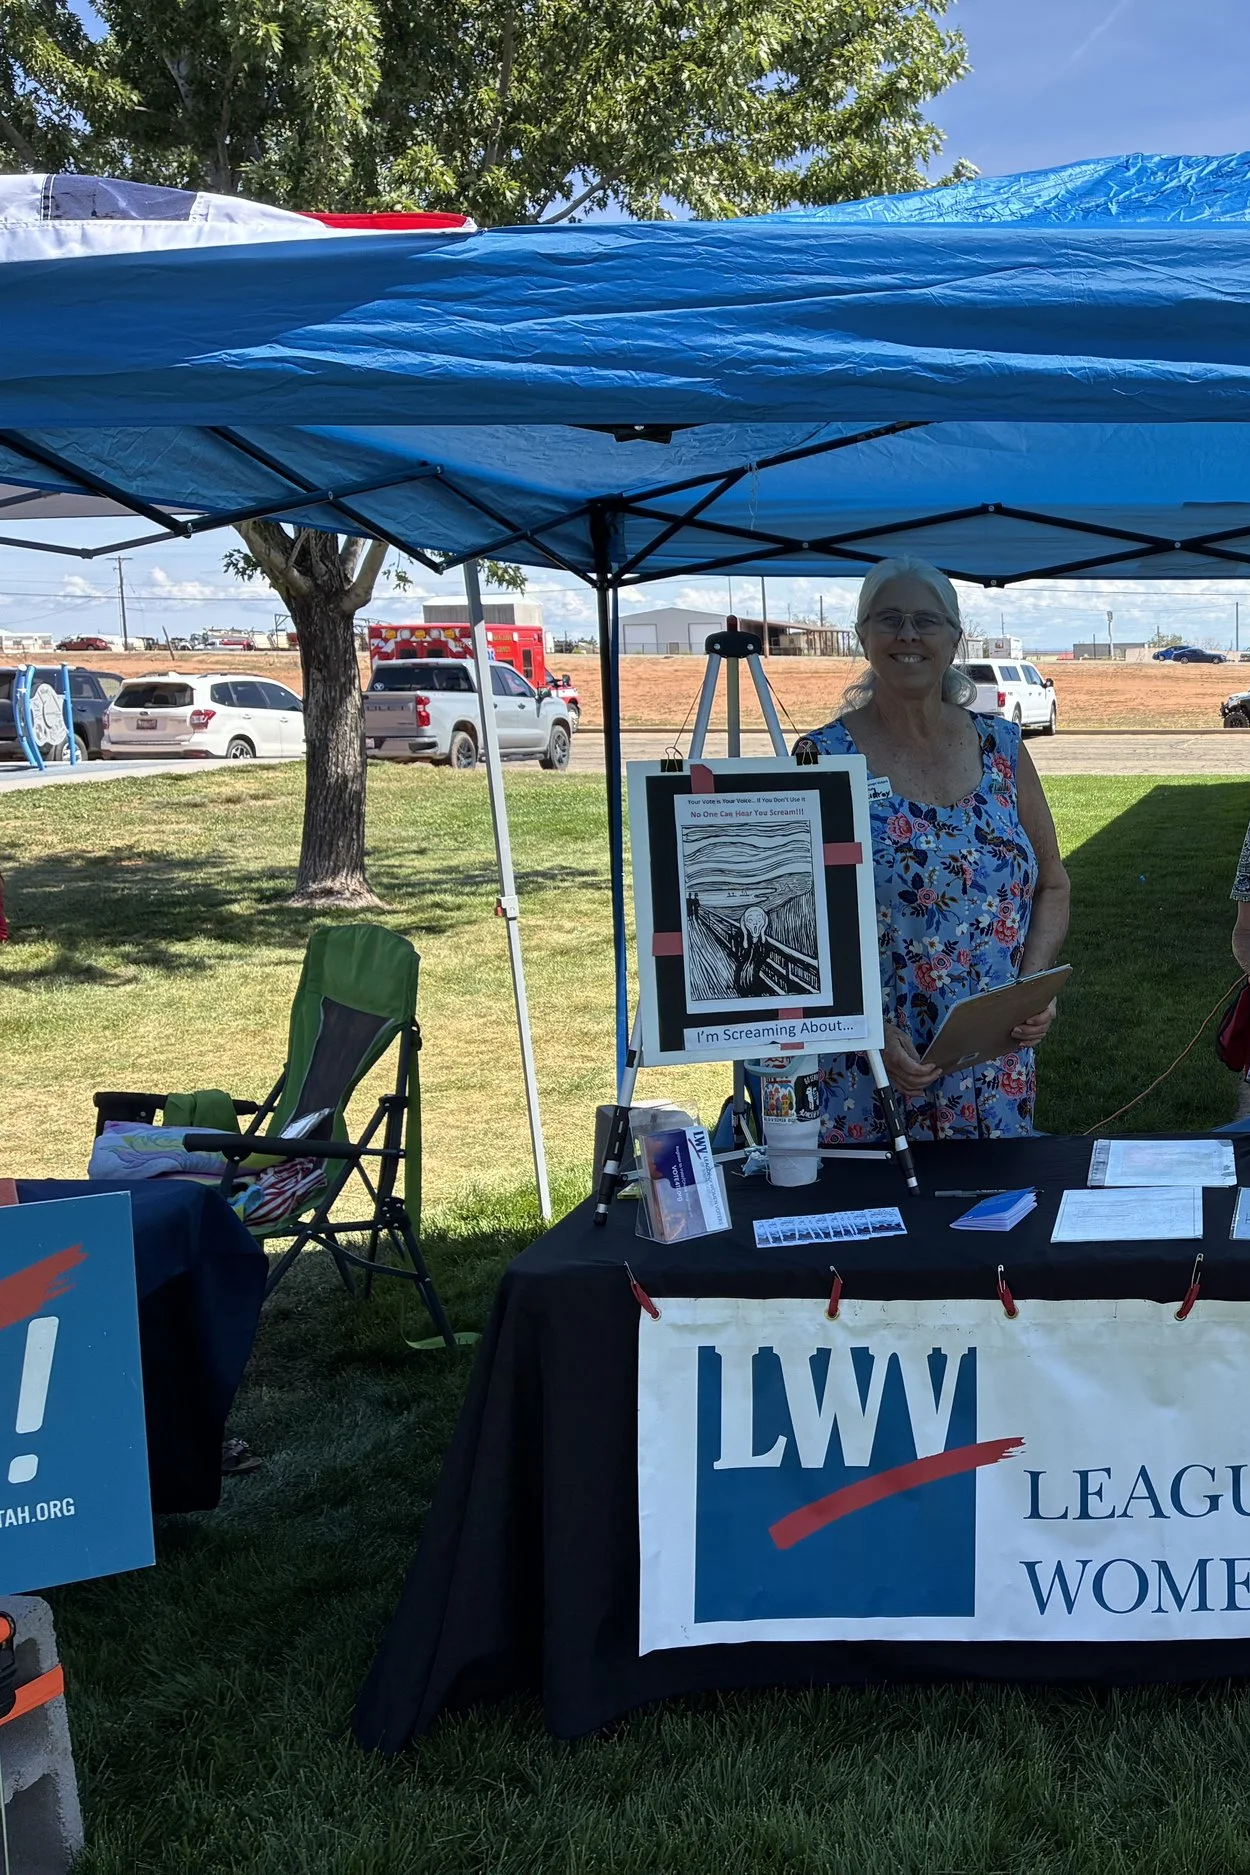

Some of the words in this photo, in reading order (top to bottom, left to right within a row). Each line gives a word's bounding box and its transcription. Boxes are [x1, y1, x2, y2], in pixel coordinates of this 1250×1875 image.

[769, 808, 804, 816] Scream!!!
[697, 1030, 719, 1044] I'm
[723, 1024, 796, 1041] Screaming
[800, 1020, 854, 1034] About...
[693, 1131, 708, 1155] LWV
[713, 1348, 965, 1471] LWV
[0, 1497, 75, 1529] TAH.ORG
